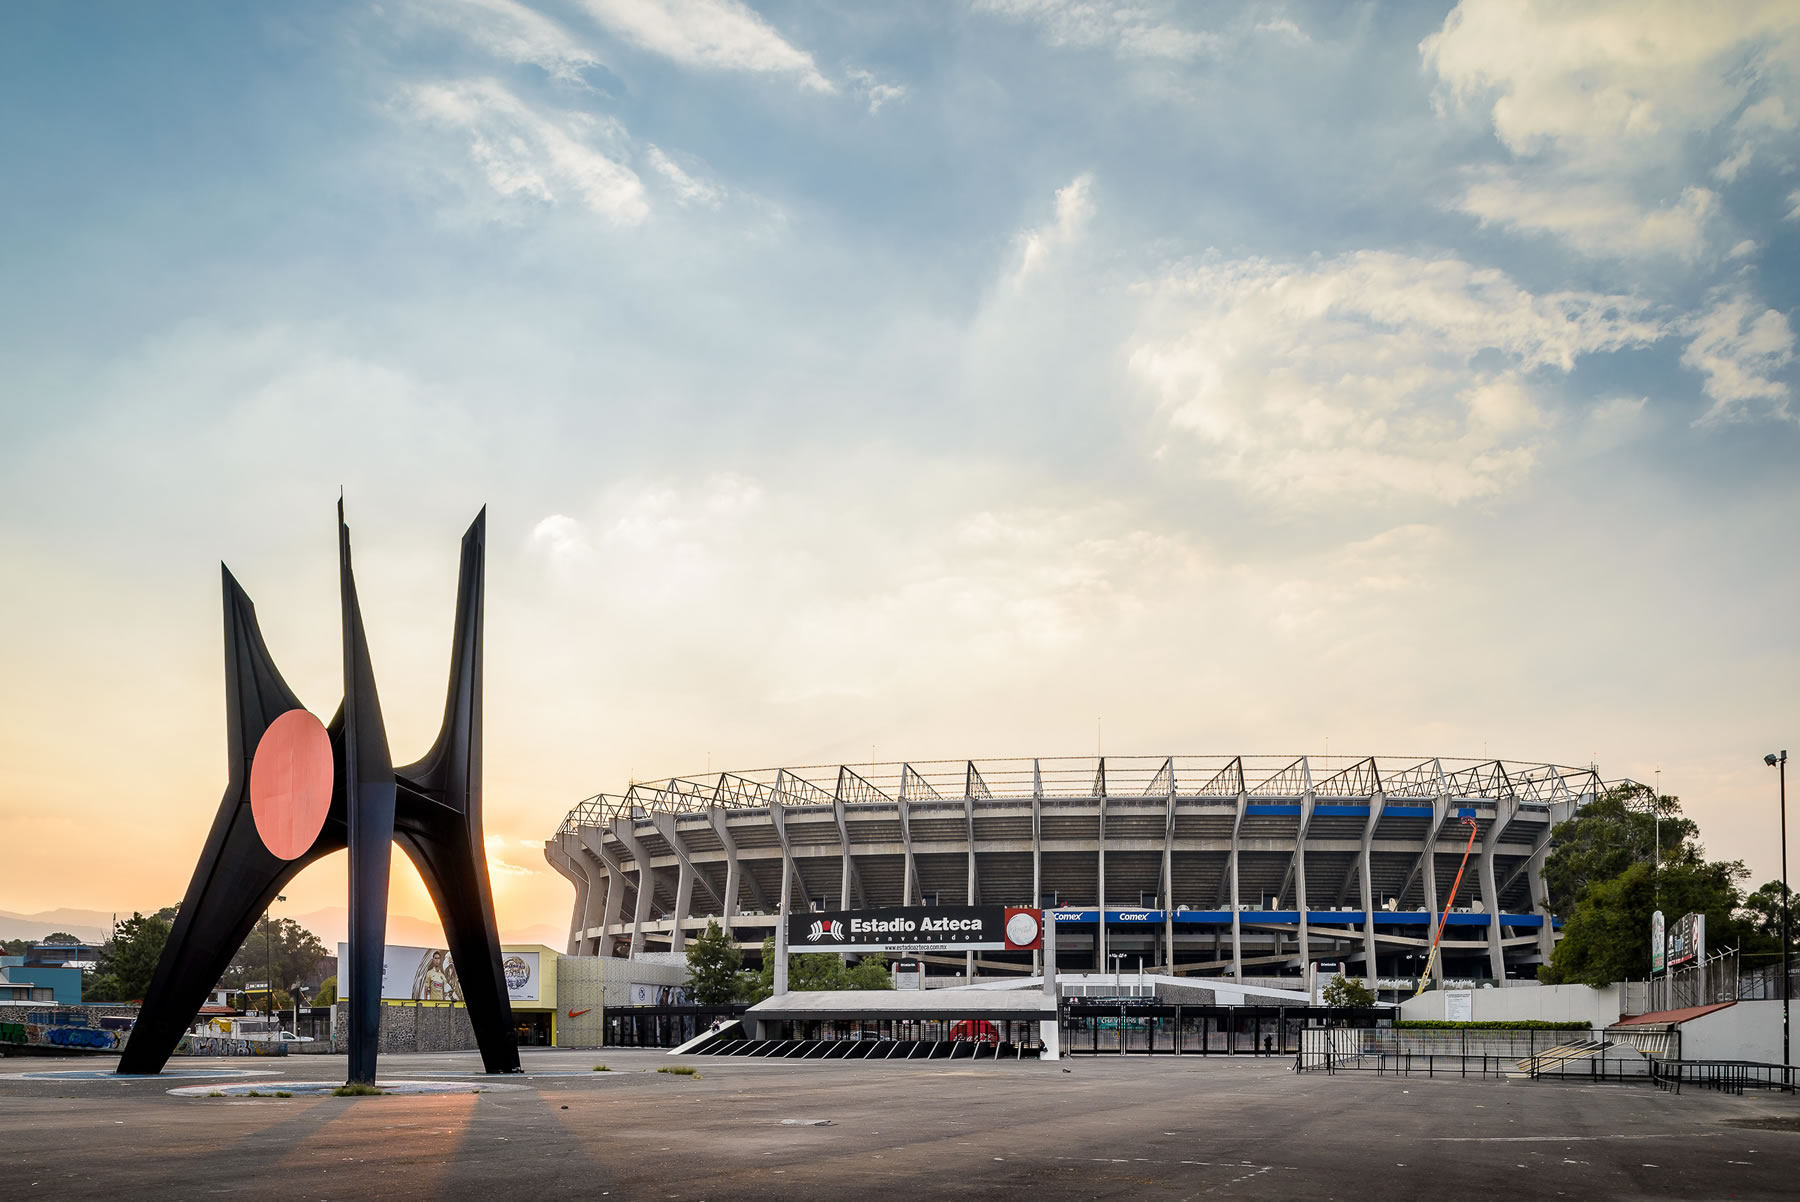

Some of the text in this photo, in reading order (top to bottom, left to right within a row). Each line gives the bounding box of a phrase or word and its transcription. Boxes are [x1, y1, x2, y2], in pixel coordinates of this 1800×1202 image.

[1054, 912, 1084, 921] Comex
[1119, 912, 1150, 921] Comex
[850, 916, 983, 933] Estadio Azteca
[850, 934, 983, 943] Bienvenidos
